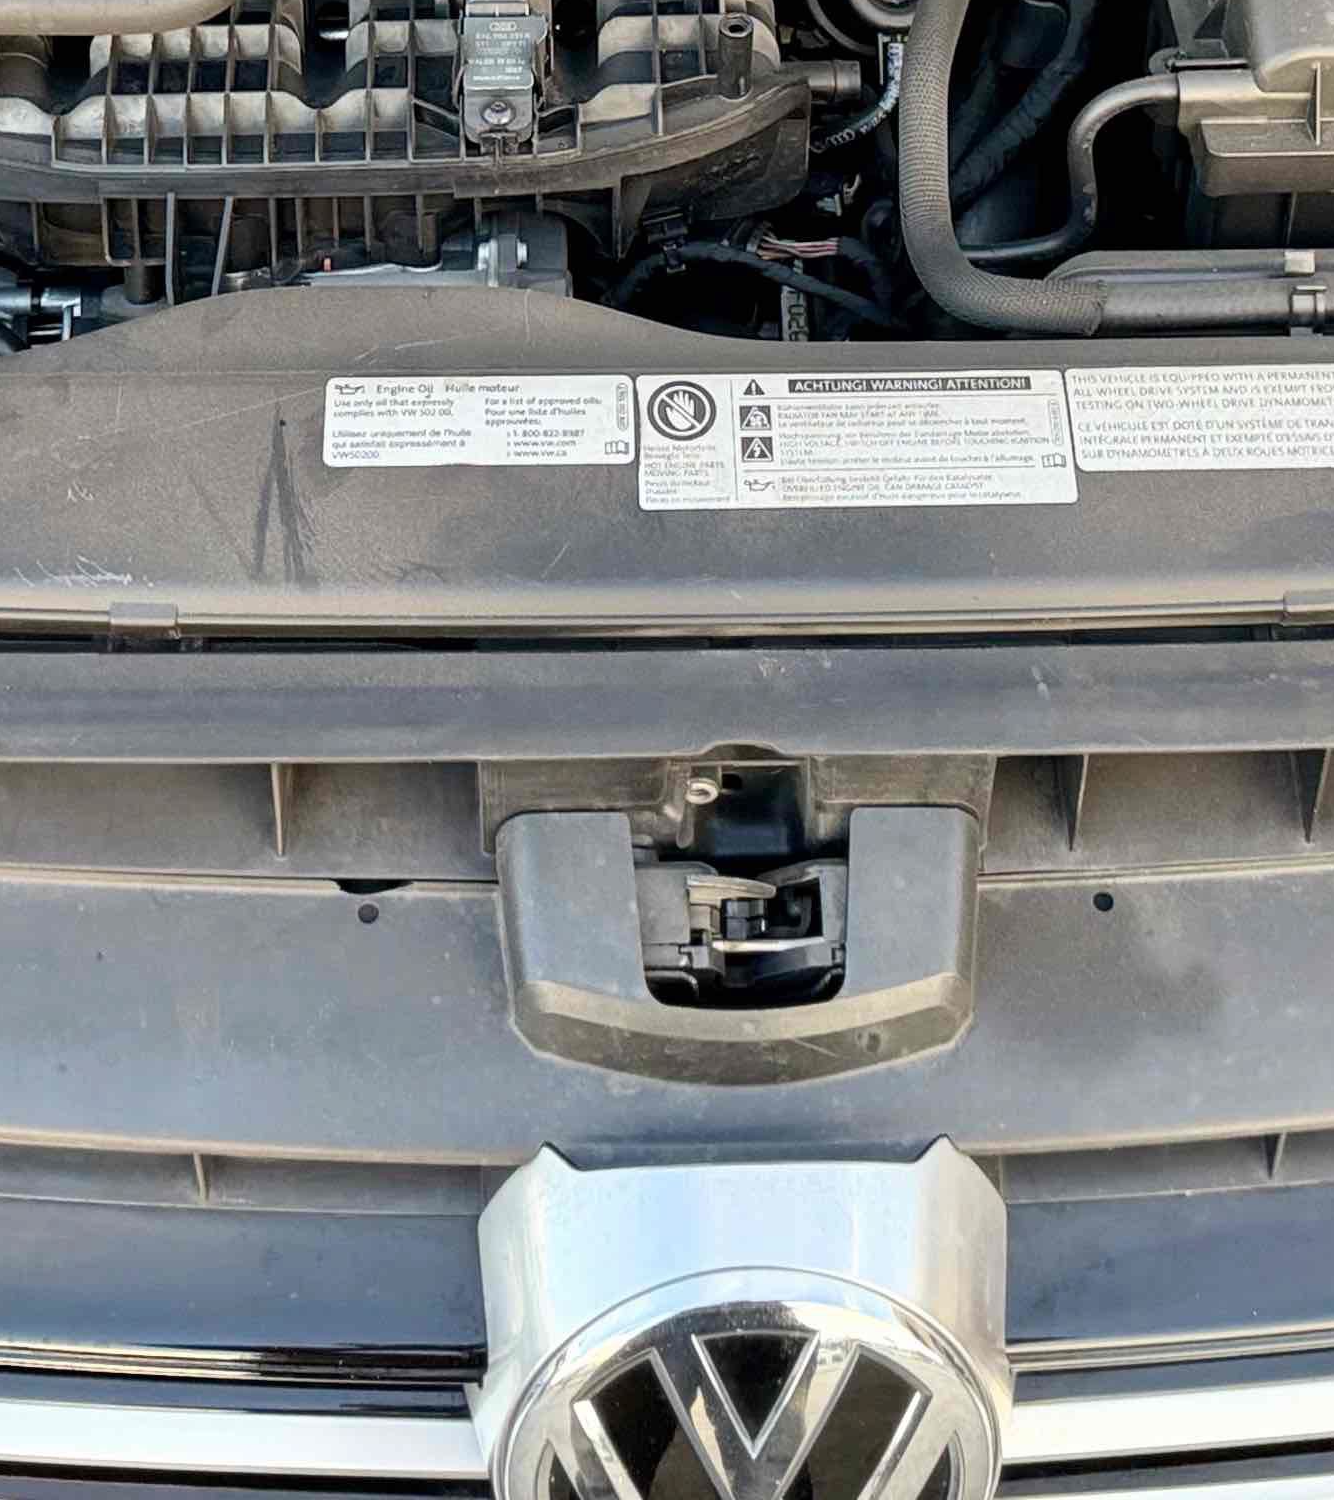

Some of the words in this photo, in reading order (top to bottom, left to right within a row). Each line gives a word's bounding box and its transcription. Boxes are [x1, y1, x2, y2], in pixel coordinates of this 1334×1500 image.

[376, 384, 415, 397] Engine
[417, 382, 434, 394] Oil
[445, 383, 475, 394] Huile
[478, 383, 520, 394] moteur
[794, 379, 867, 393] ACHTUNG!
[870, 378, 943, 392] WARNING!
[945, 377, 1027, 391] ATTENTION!
[401, 408, 418, 417] VW
